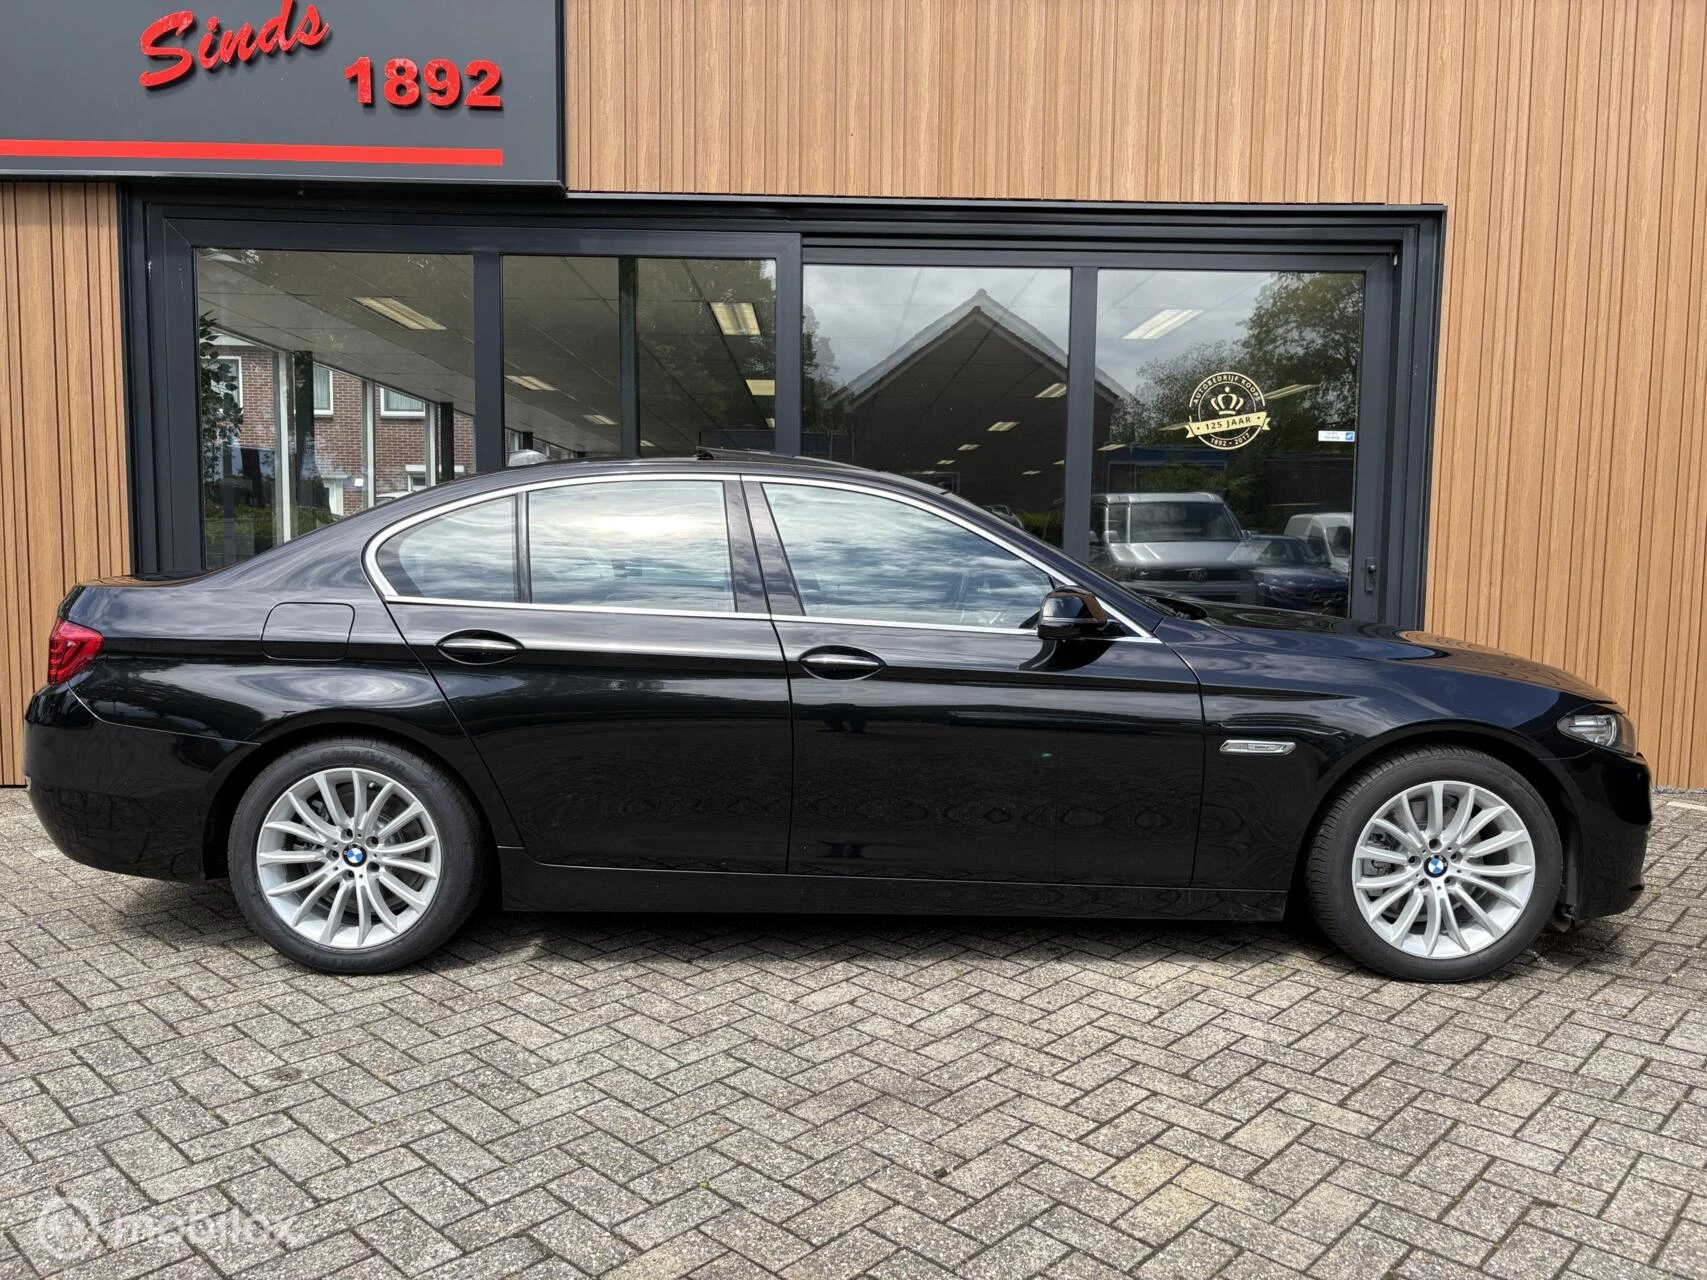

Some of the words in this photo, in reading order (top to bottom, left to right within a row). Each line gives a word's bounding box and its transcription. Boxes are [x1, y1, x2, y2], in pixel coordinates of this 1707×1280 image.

[139, 0, 330, 87] Sinds
[344, 57, 503, 107] 1892
[1193, 375, 1240, 404] AUTOBEDRIJF
[1241, 379, 1261, 402] KOOPS
[1205, 421, 1223, 431] 125
[1226, 416, 1252, 429] JAAR
[1210, 437, 1227, 447] 1892
[1234, 432, 1251, 445] 2017
